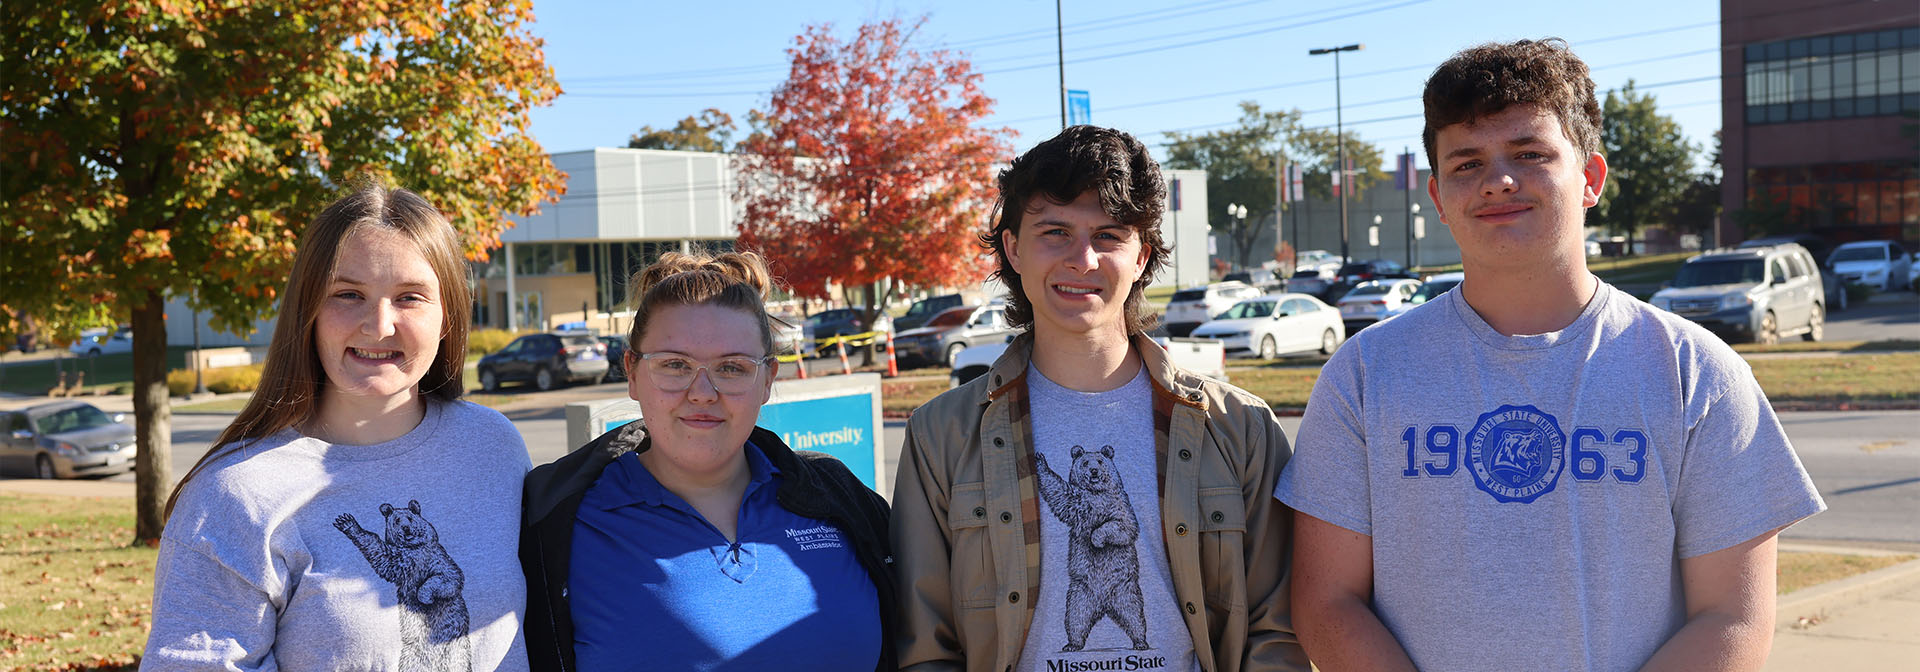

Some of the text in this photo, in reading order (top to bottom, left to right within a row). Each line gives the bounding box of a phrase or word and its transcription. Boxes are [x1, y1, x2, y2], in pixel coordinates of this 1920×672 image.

[1472, 411, 1561, 464] MISSOURI STATE UNIVERSITY
[1401, 423, 1650, 485] 19 63
[1485, 477, 1548, 498] WEST PLAINS
[785, 526, 821, 538] Missouri
[1046, 654, 1166, 672] Missouri State
